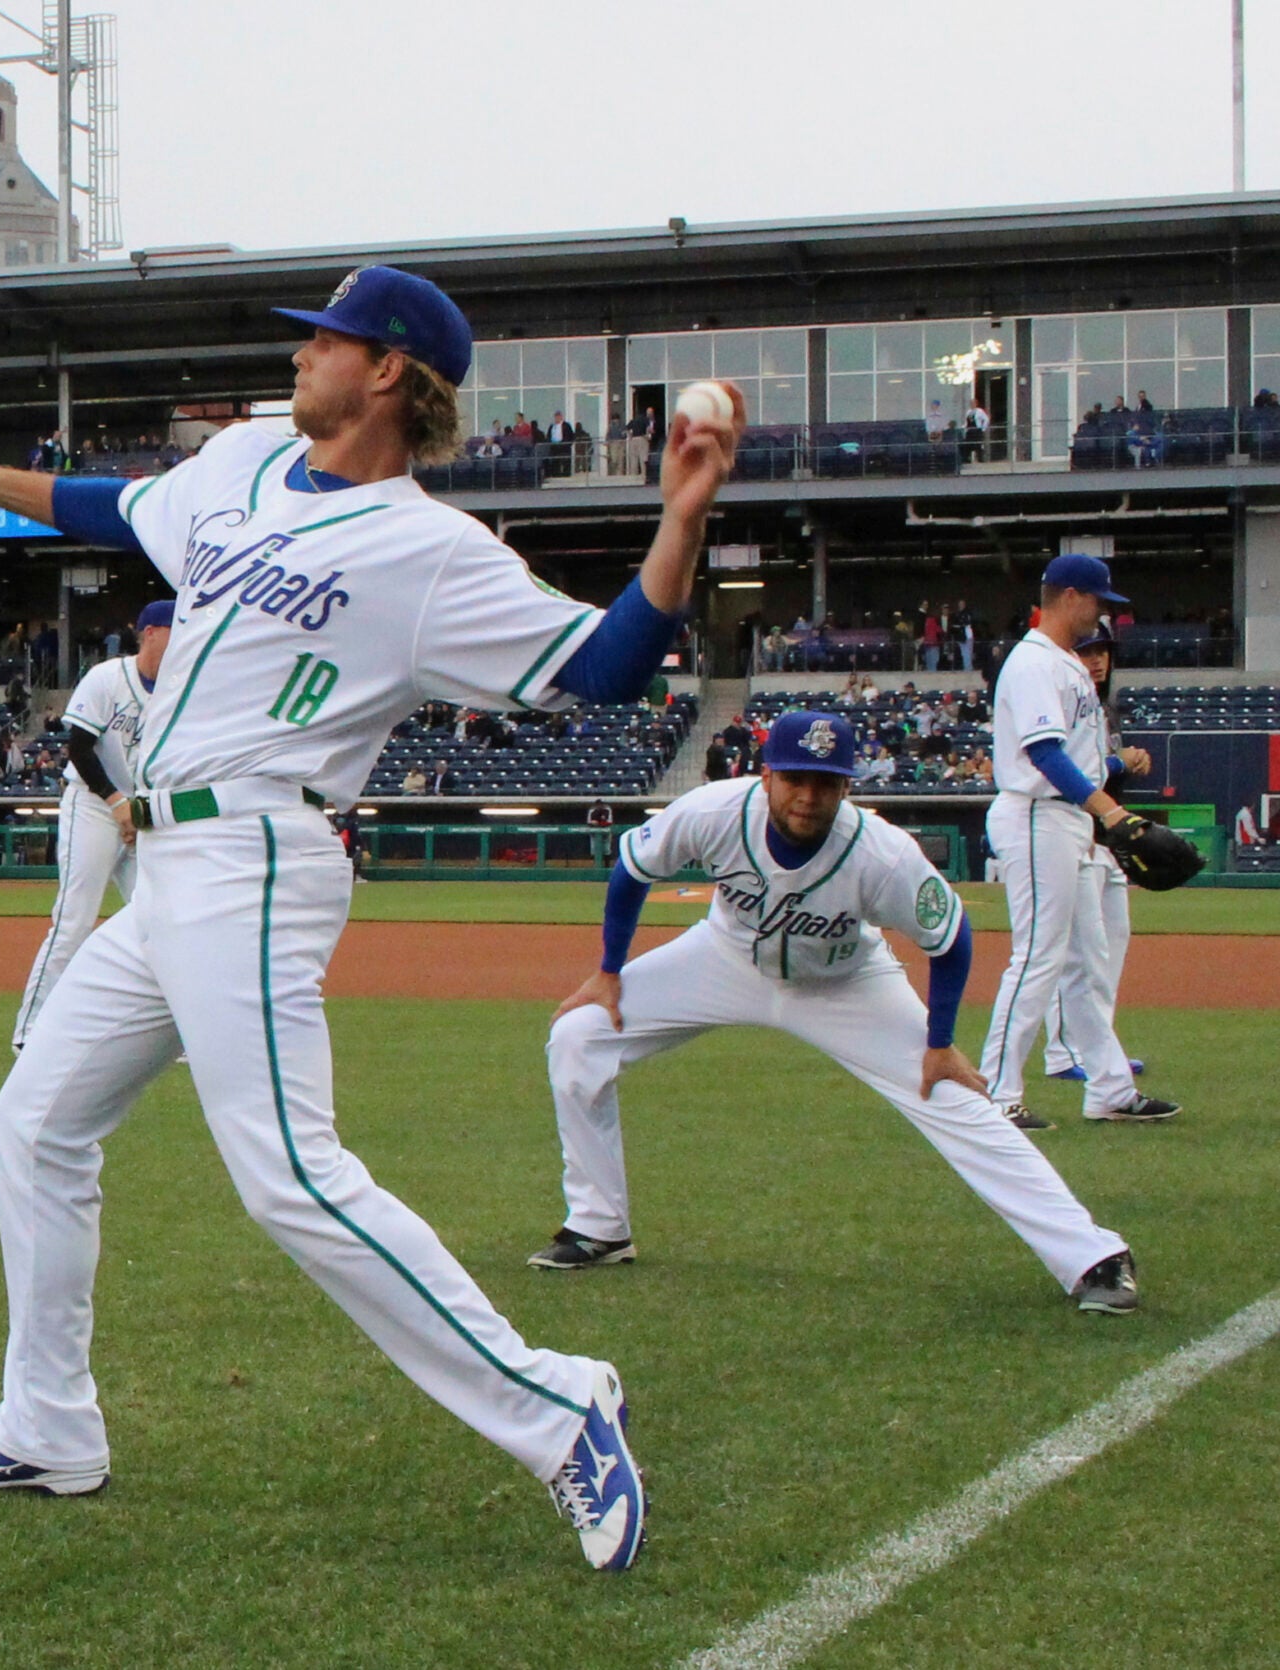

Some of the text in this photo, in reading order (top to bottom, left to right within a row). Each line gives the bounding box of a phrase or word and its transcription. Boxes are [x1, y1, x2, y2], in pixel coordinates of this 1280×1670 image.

[190, 533, 350, 631] Goats
[266, 652, 339, 727] 18
[756, 893, 857, 941] Goats
